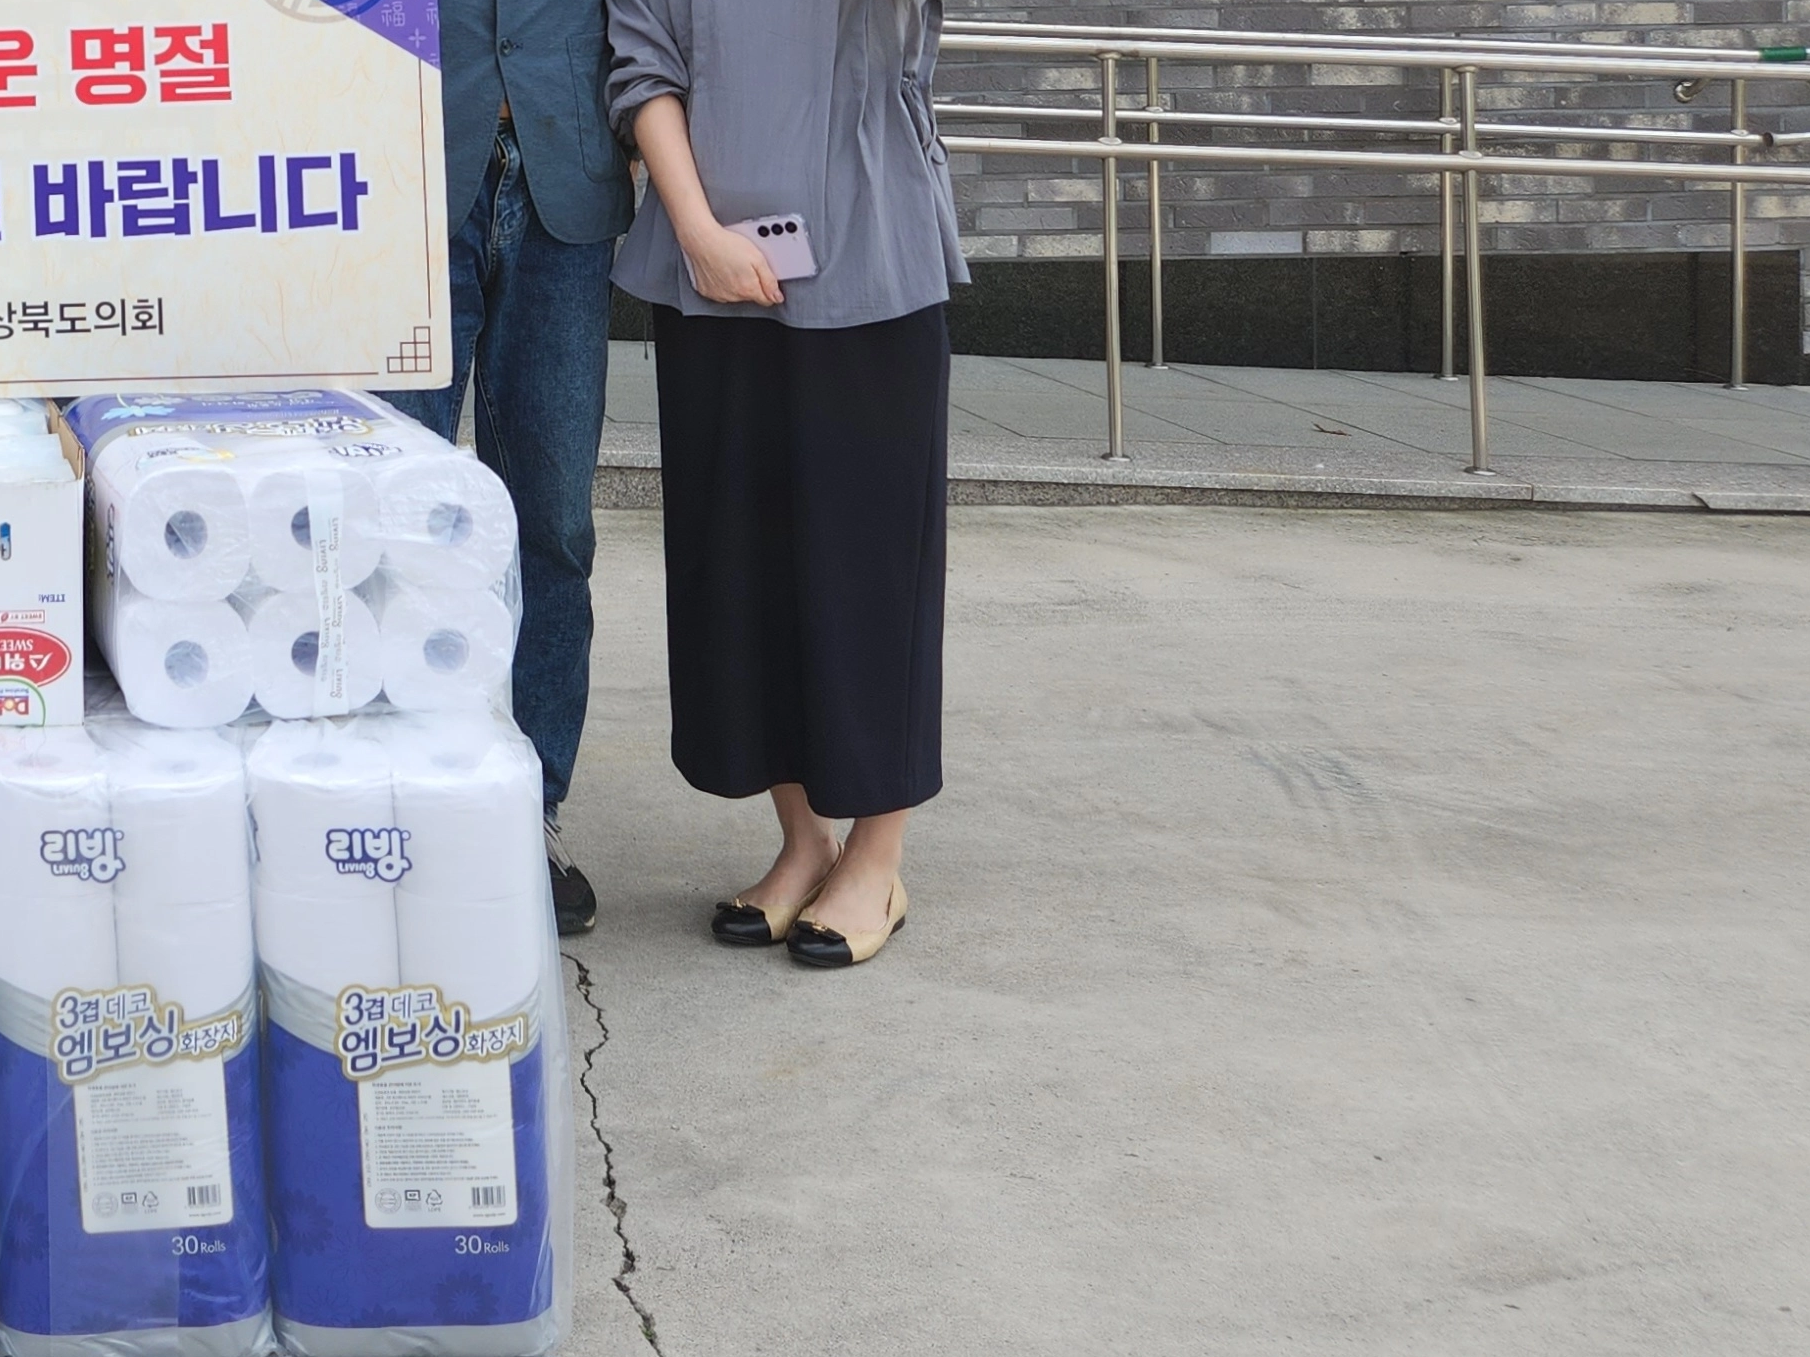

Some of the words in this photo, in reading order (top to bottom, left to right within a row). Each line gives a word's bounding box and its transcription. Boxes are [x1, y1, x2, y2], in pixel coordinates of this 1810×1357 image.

[70, 22, 233, 106] 명절
[33, 152, 368, 240] 바랍니다
[40, 827, 126, 883] 리빙
[325, 827, 412, 883] 리빙
[60, 995, 99, 1029] 3겹
[106, 992, 150, 1020] 데코
[344, 992, 385, 1025] 3겹
[391, 992, 436, 1019] 데코
[57, 1009, 175, 1077] 엠보싱
[180, 1018, 236, 1053] 화장지
[342, 1009, 460, 1072] 엠보싱
[467, 1020, 522, 1054] 화장지
[171, 1235, 199, 1255] 30
[200, 1240, 226, 1253] Rolls
[455, 1235, 482, 1254] 30
[484, 1240, 510, 1253] Rolls
